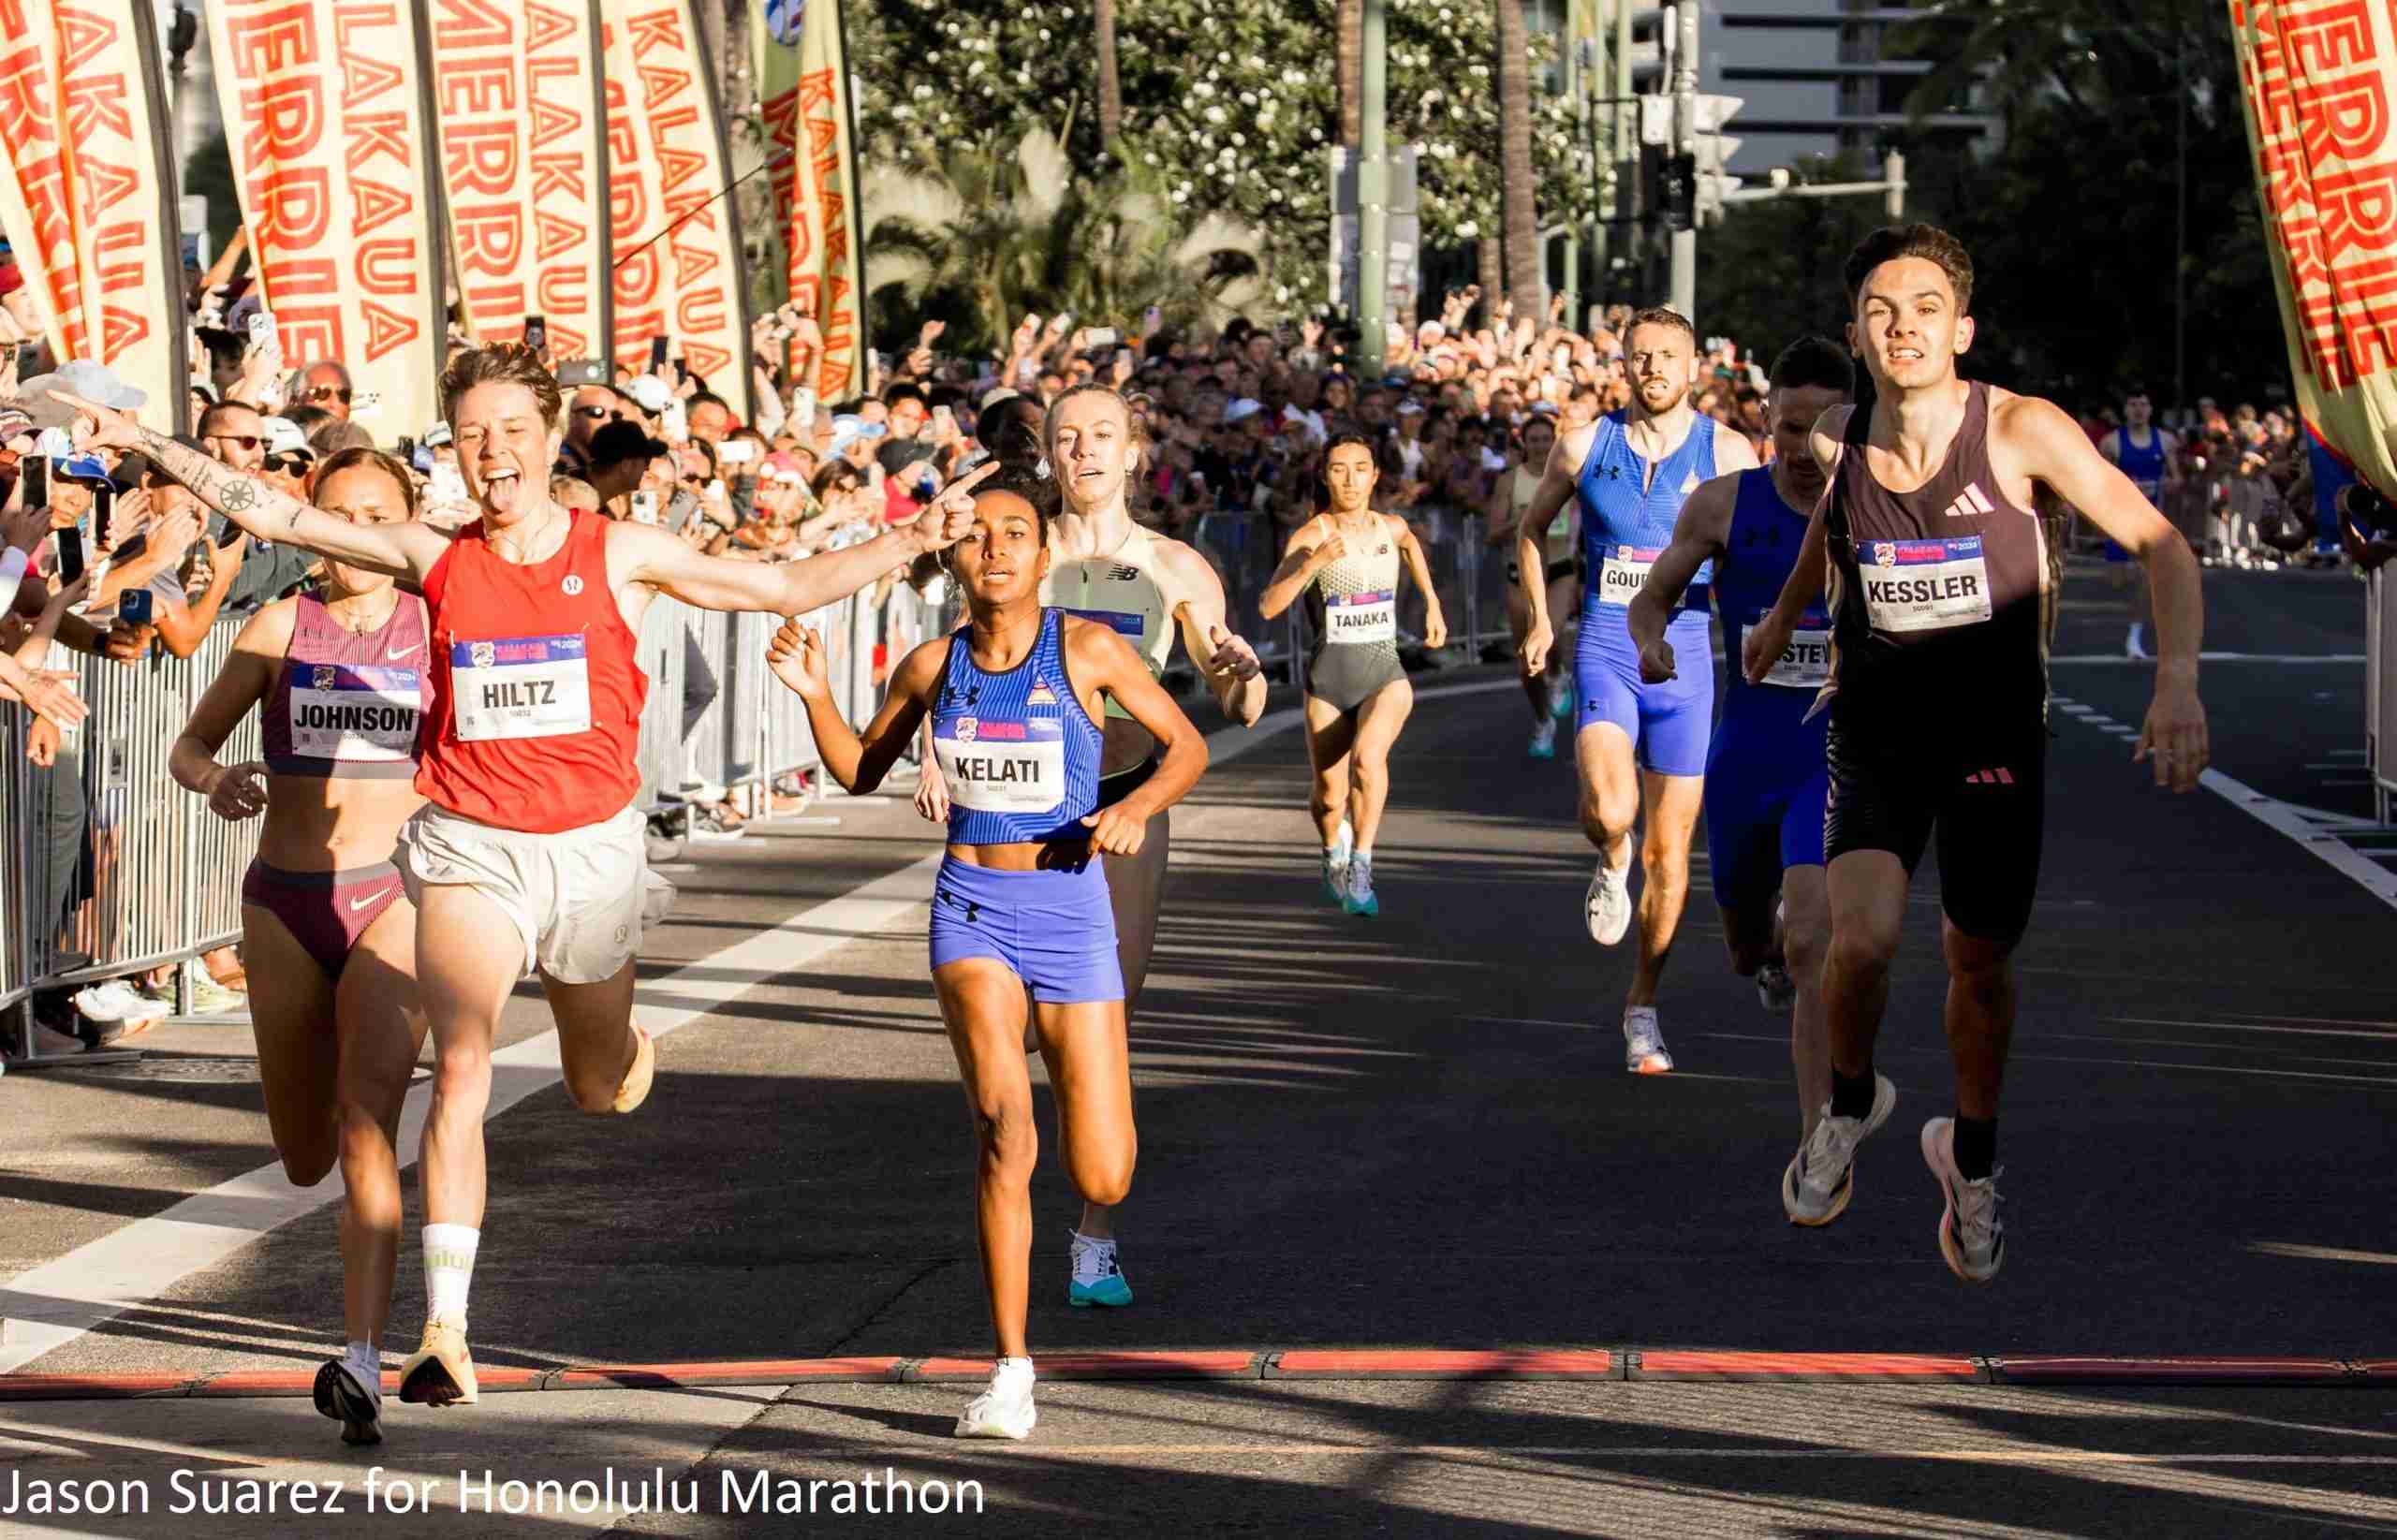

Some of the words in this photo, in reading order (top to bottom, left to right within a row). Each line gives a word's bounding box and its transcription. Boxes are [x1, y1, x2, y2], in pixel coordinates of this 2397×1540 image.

[225, 0, 347, 369] ERRIE
[435, 0, 525, 343] MERRI
[626, 7, 732, 378] KALAKAUA
[2274, 0, 2397, 376] ERRIE
[1867, 575, 1978, 604] KESSLER
[1334, 611, 1389, 627] TANAKA
[482, 680, 556, 709] HILTZ
[294, 704, 413, 731] JOHNSON
[954, 756, 1040, 783] KELATI
